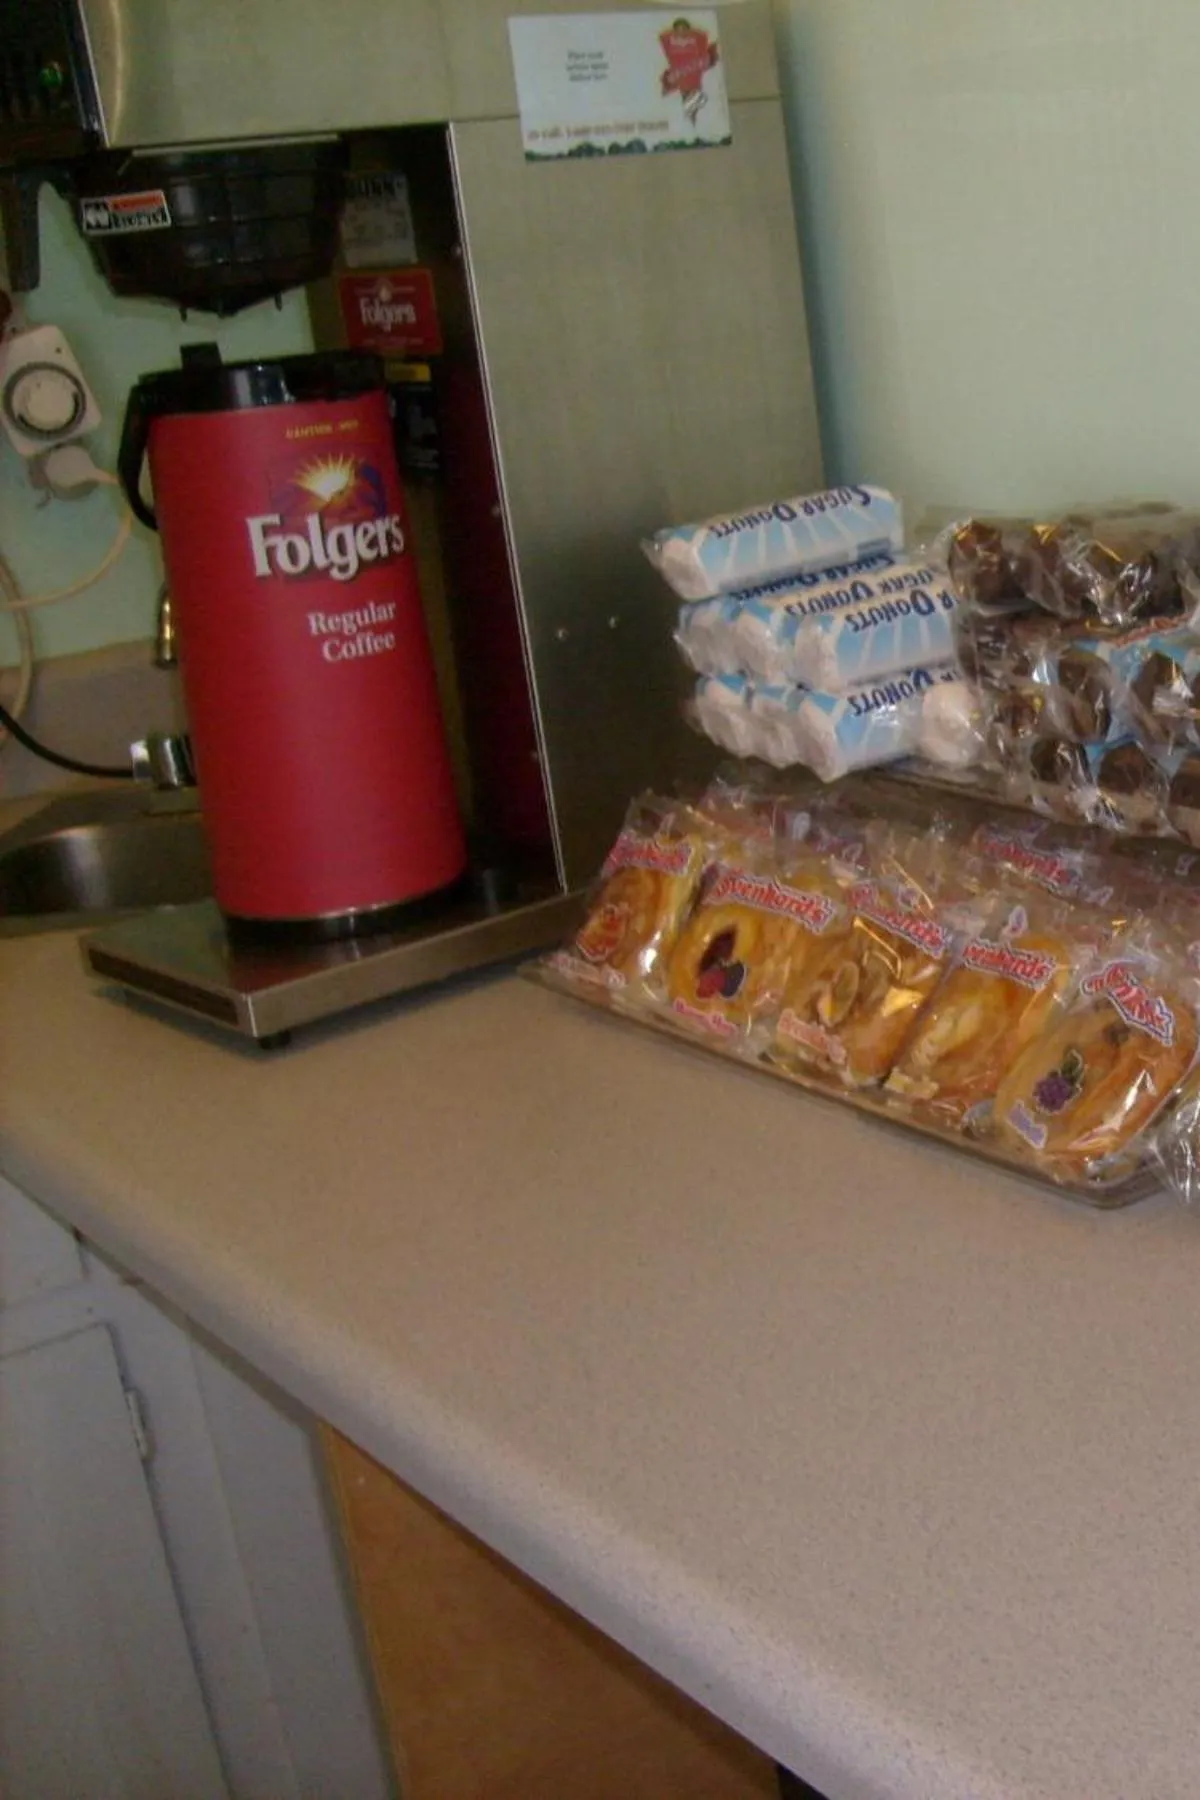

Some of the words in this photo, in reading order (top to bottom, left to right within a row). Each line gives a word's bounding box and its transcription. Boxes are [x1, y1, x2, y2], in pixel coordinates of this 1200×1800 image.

[360, 297, 416, 333] Folgers
[803, 484, 874, 517] SUGAR
[709, 503, 798, 538] DONUTS
[246, 513, 405, 581] Folgers
[308, 601, 397, 637] Regular
[846, 588, 935, 633] DONUTS
[322, 631, 396, 663] Coffee
[846, 668, 935, 717] DONUTS
